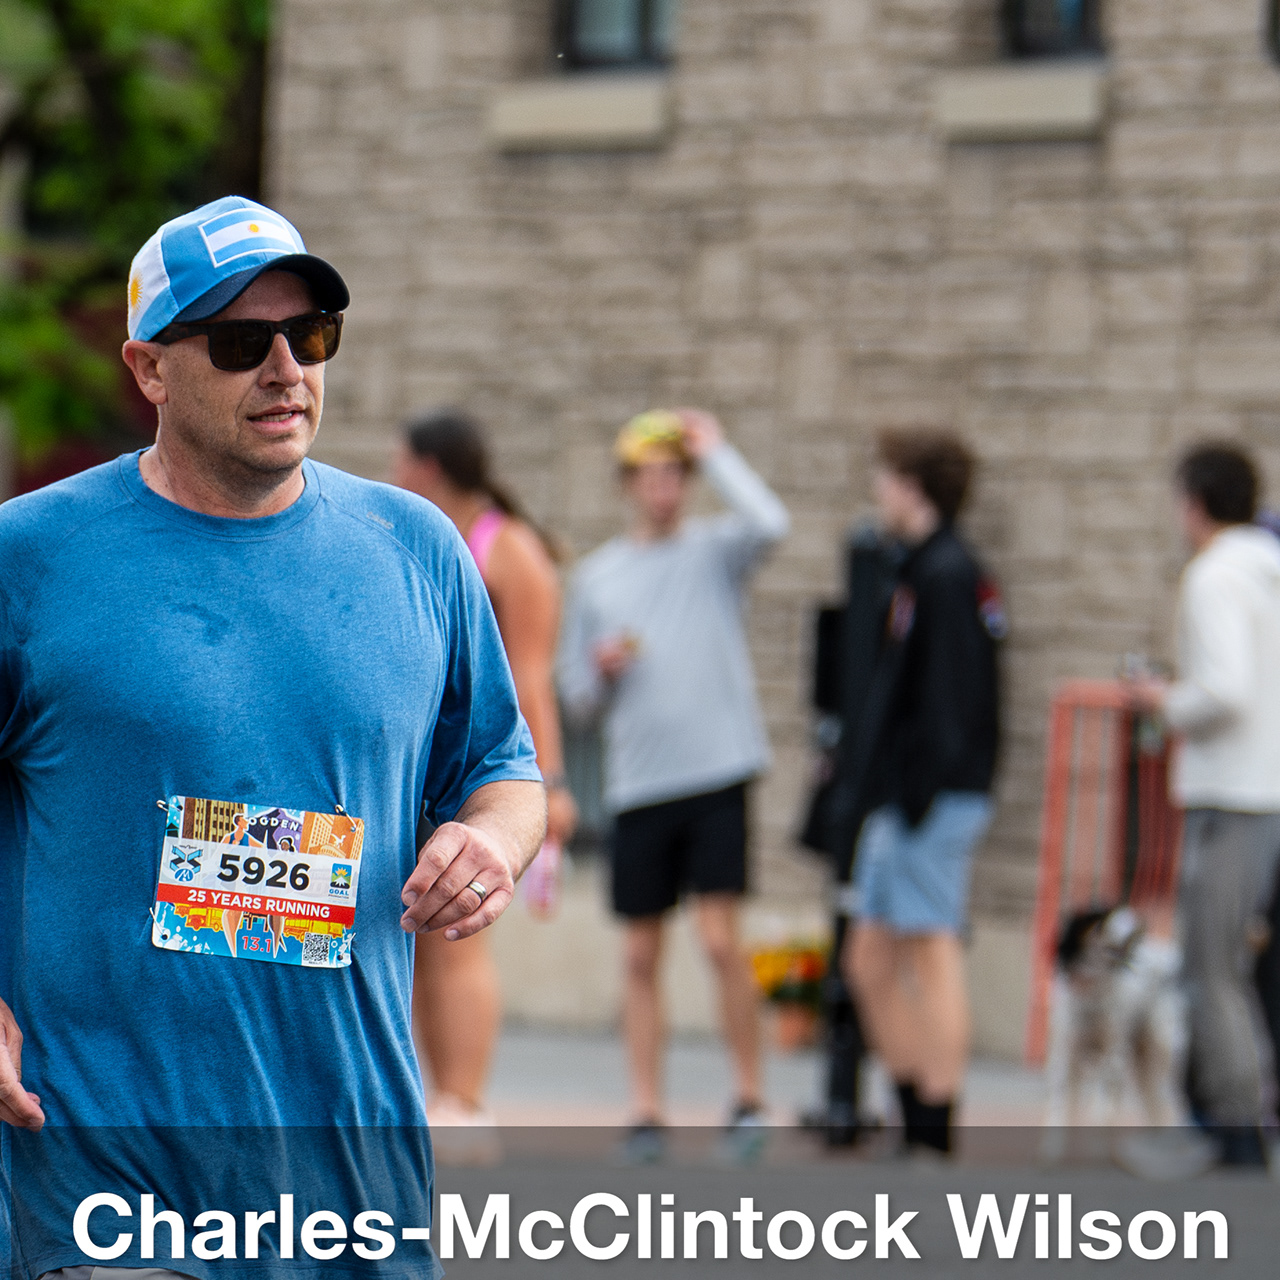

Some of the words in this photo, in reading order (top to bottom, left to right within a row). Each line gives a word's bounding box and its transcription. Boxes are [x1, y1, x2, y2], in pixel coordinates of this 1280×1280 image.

[248, 816, 300, 832] OGDEN
[216, 853, 310, 891] 5926
[329, 888, 350, 896] GOAL
[187, 889, 207, 903] 25
[211, 892, 262, 910] YEARS
[265, 899, 331, 918] RUNNING
[241, 936, 272, 953] 13.1
